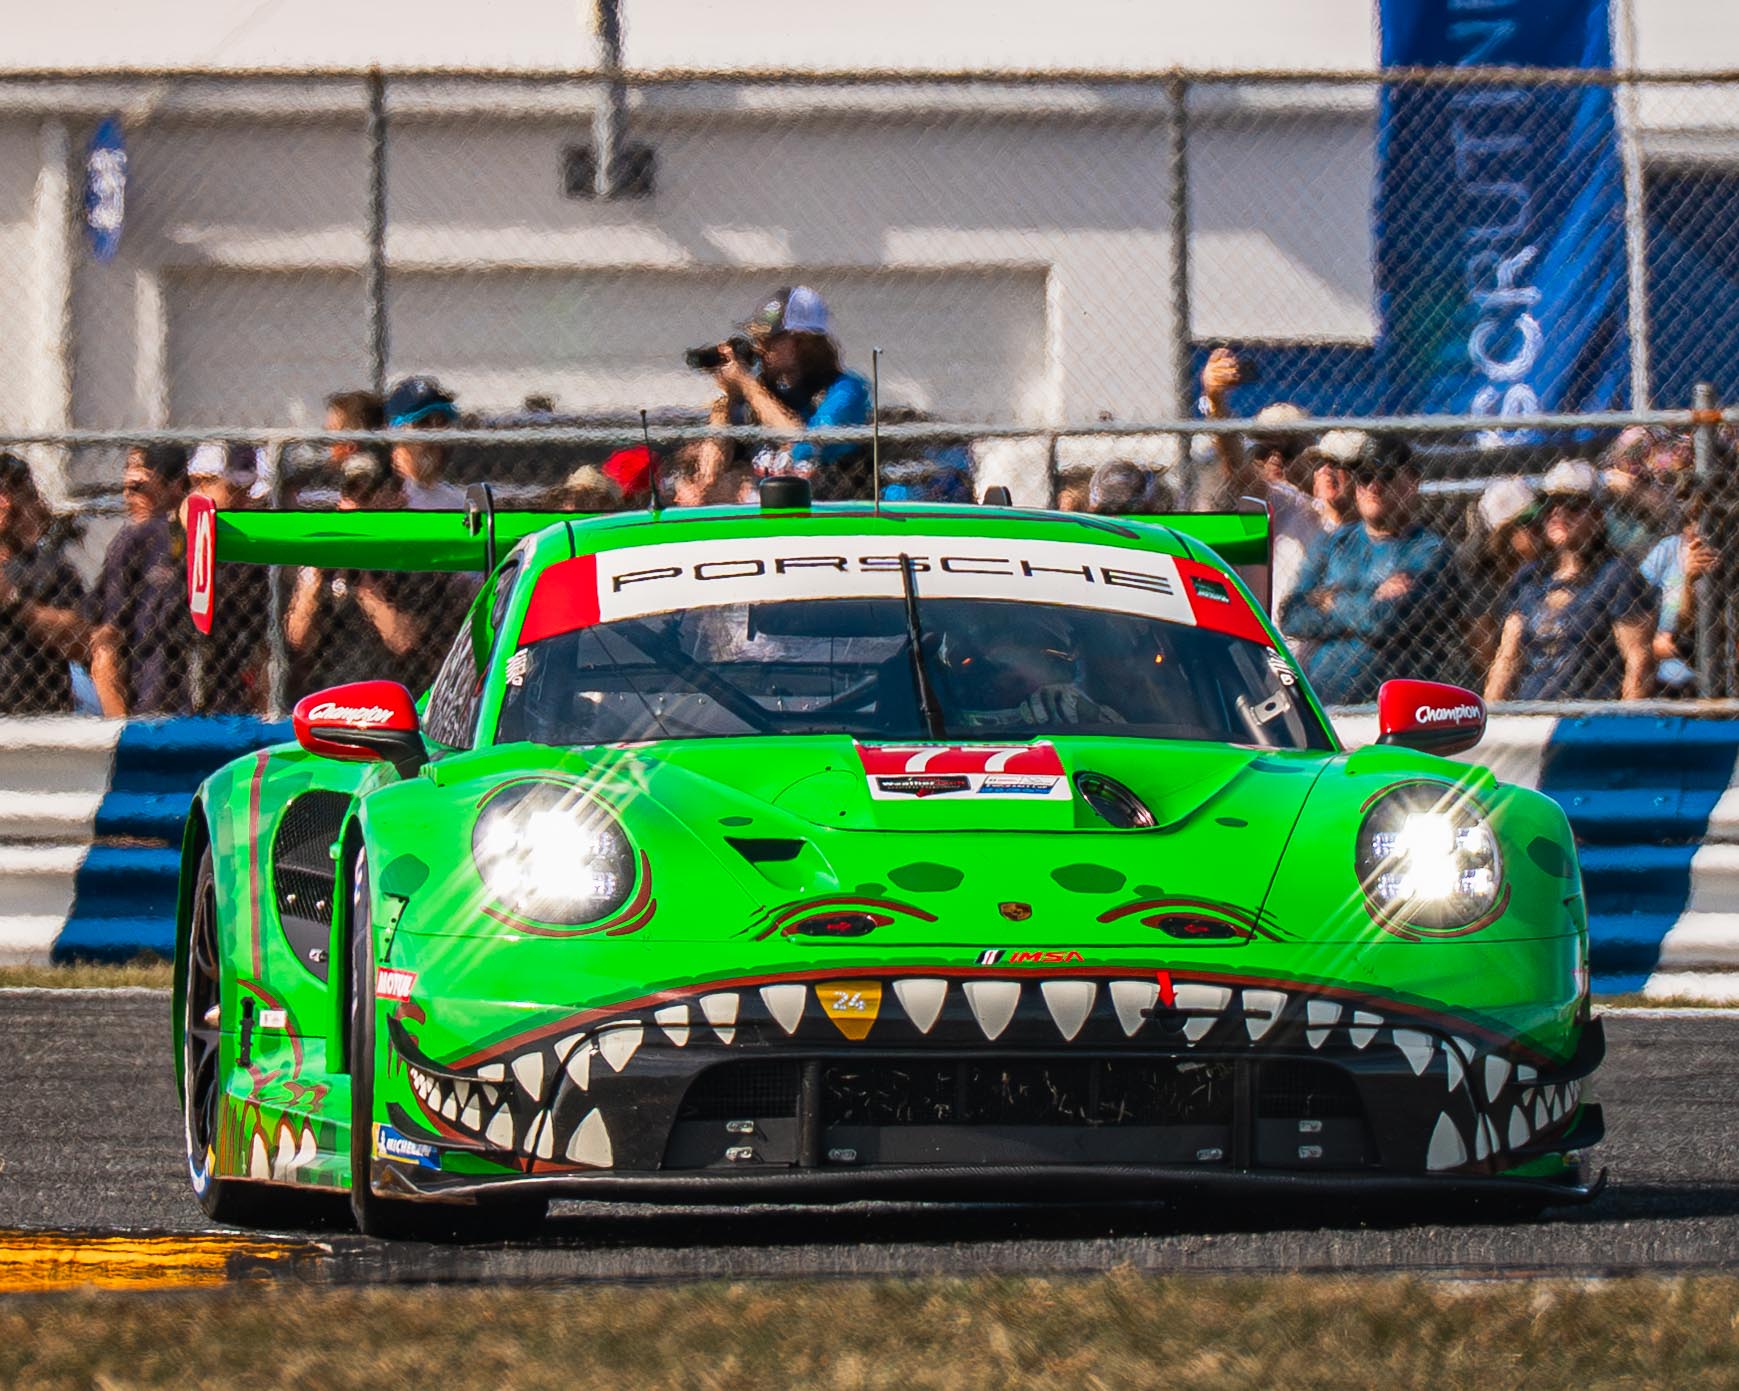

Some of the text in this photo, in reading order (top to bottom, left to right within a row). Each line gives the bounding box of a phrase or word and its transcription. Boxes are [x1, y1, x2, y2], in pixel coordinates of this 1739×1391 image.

[612, 556, 1174, 596] PORSCHE
[308, 702, 395, 724] Champion
[1415, 704, 1481, 725] Champion
[881, 746, 1029, 773] 77
[1008, 950, 1085, 963] IMSA
[377, 971, 413, 997] MOTUL
[832, 991, 865, 1011] 24
